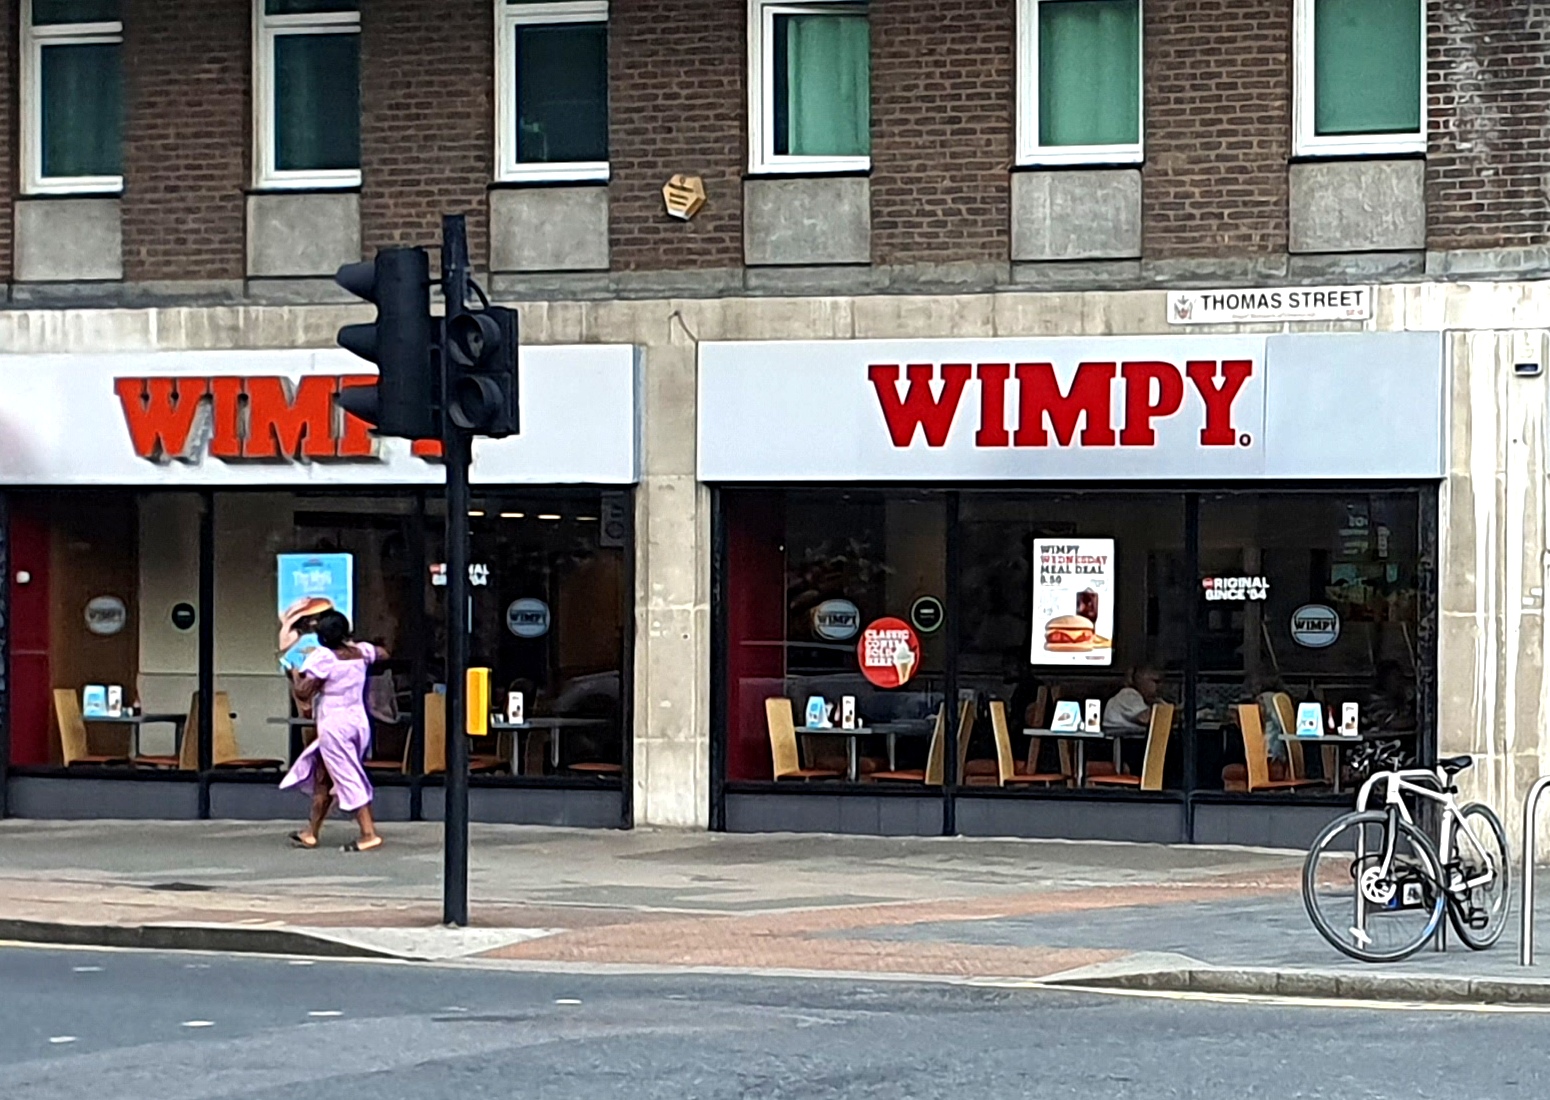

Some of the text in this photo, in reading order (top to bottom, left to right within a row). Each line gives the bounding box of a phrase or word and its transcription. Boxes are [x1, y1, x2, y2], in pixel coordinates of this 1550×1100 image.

[1200, 290, 1364, 311] THOMAS STREET
[868, 360, 1253, 447] WIMPY
[1040, 565, 1104, 574] MEAL DEAL
[1294, 620, 1337, 631] WIMPY
